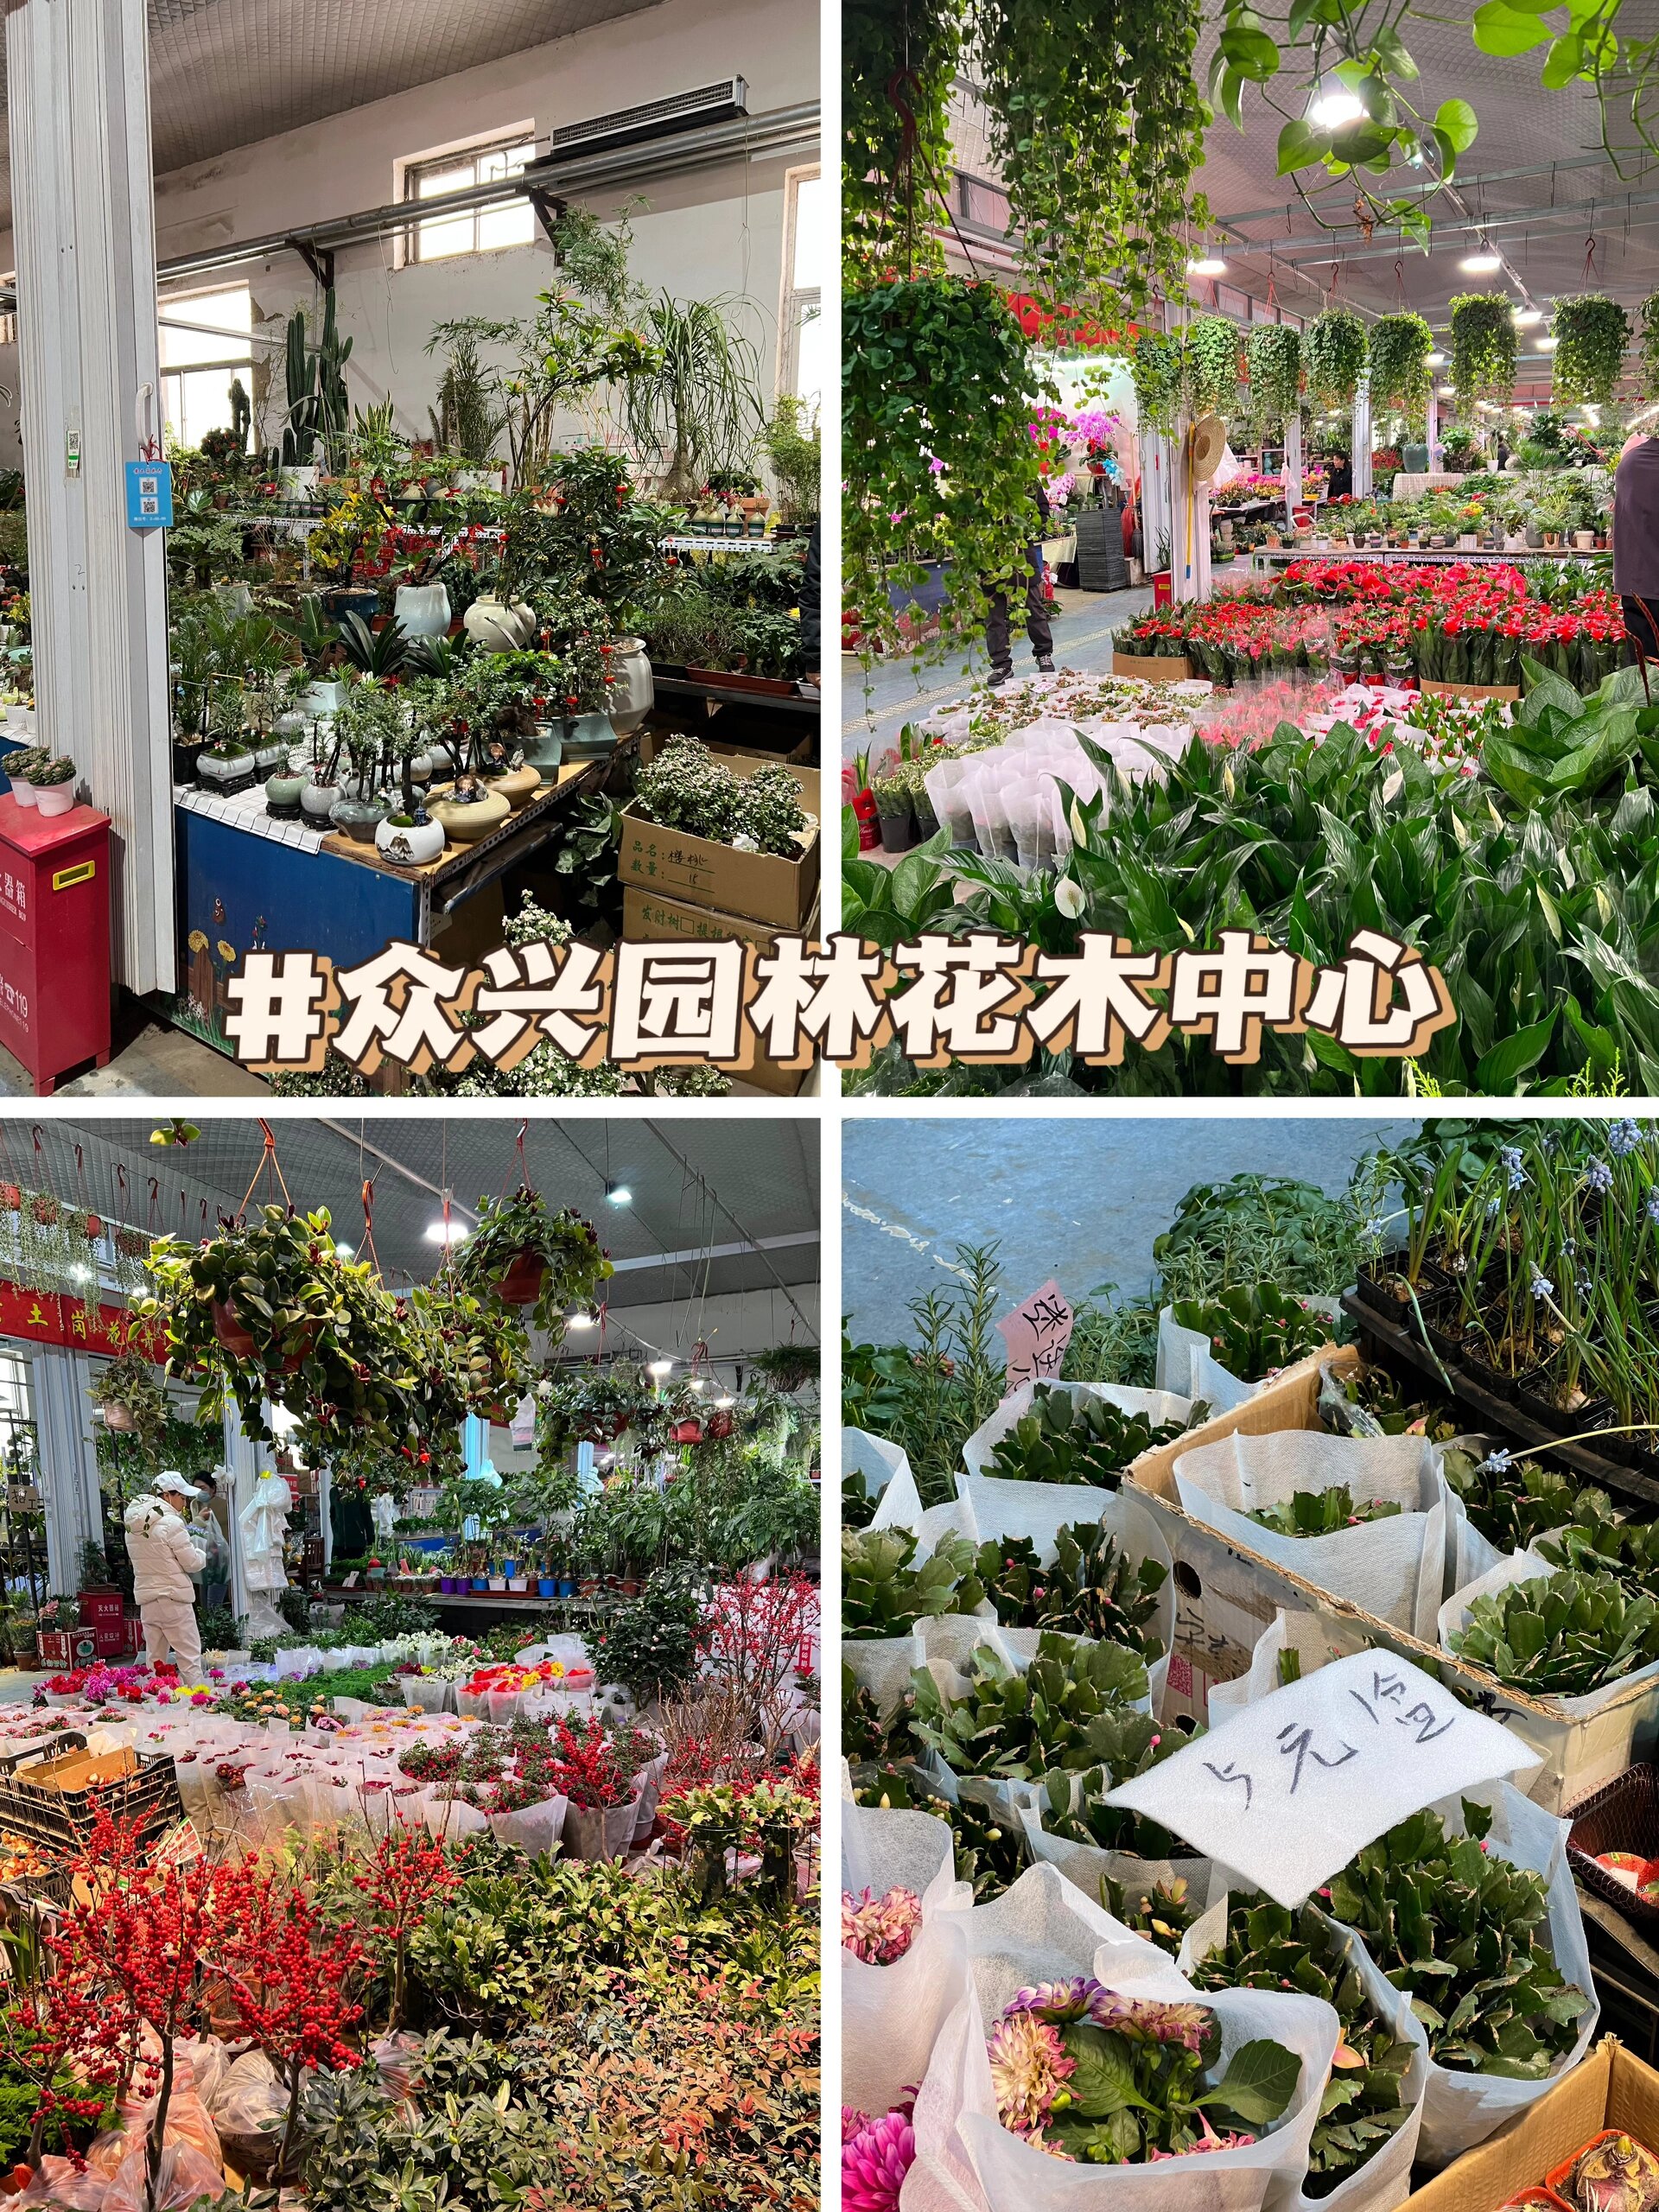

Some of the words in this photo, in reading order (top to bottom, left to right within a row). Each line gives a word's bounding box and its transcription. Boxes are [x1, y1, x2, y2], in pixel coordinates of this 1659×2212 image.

[0, 872, 26, 909] 器箱
[16, 989, 28, 1018] 119
[0, 1302, 156, 1353] 土岗花卉
